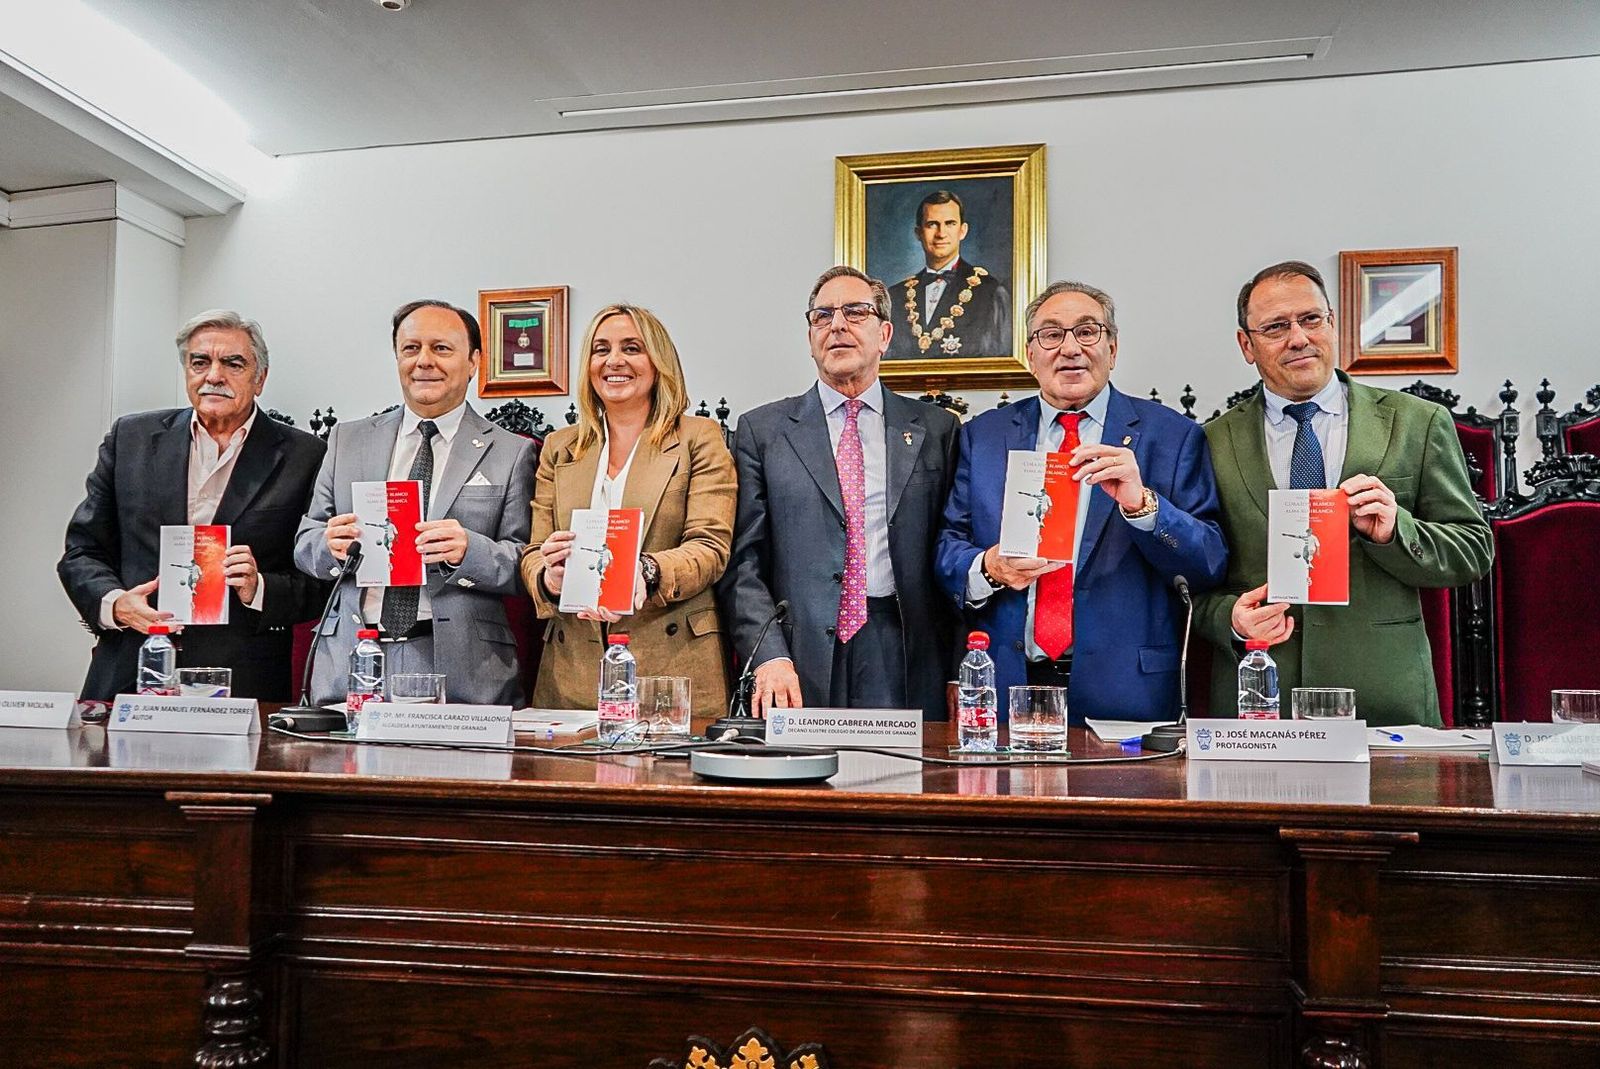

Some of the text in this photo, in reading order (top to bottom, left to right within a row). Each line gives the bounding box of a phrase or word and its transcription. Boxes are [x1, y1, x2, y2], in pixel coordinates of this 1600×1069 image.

[161, 705, 188, 713] MANUEL
[407, 712, 443, 721] FRANCISCA
[444, 713, 470, 721] CARAZO
[471, 714, 511, 723] VILLALONGA
[798, 718, 836, 726] LEANDRO
[837, 719, 874, 727] CABRERA
[875, 720, 917, 729] MERCADO
[1215, 729, 1327, 740] D. JOSÉ MACANÁS PÉREZ
[1524, 735, 1535, 743] D.
[1216, 742, 1278, 750] PROTAGONISTA
